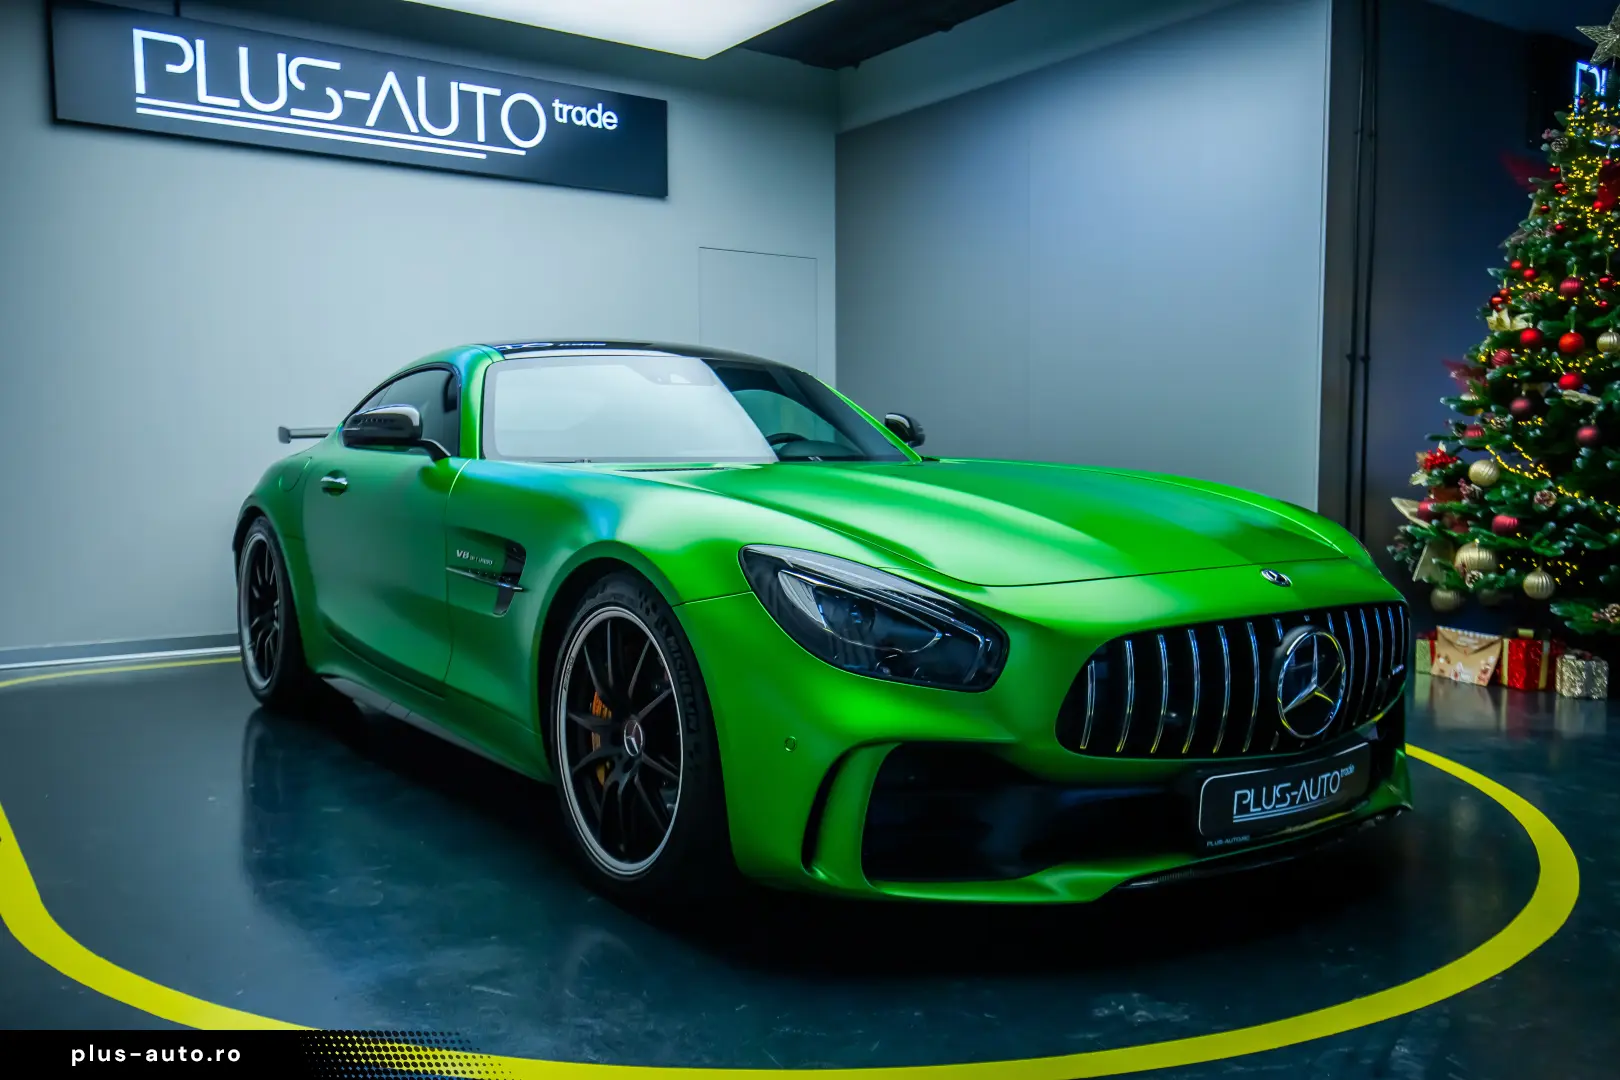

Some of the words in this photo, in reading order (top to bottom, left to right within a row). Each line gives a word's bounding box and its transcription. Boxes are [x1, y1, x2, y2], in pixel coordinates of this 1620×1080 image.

[132, 28, 547, 149] PLUS-AUTO
[552, 98, 619, 131] trade
[456, 549, 470, 559] V8
[1233, 770, 1341, 815] PLUS-AUTO
